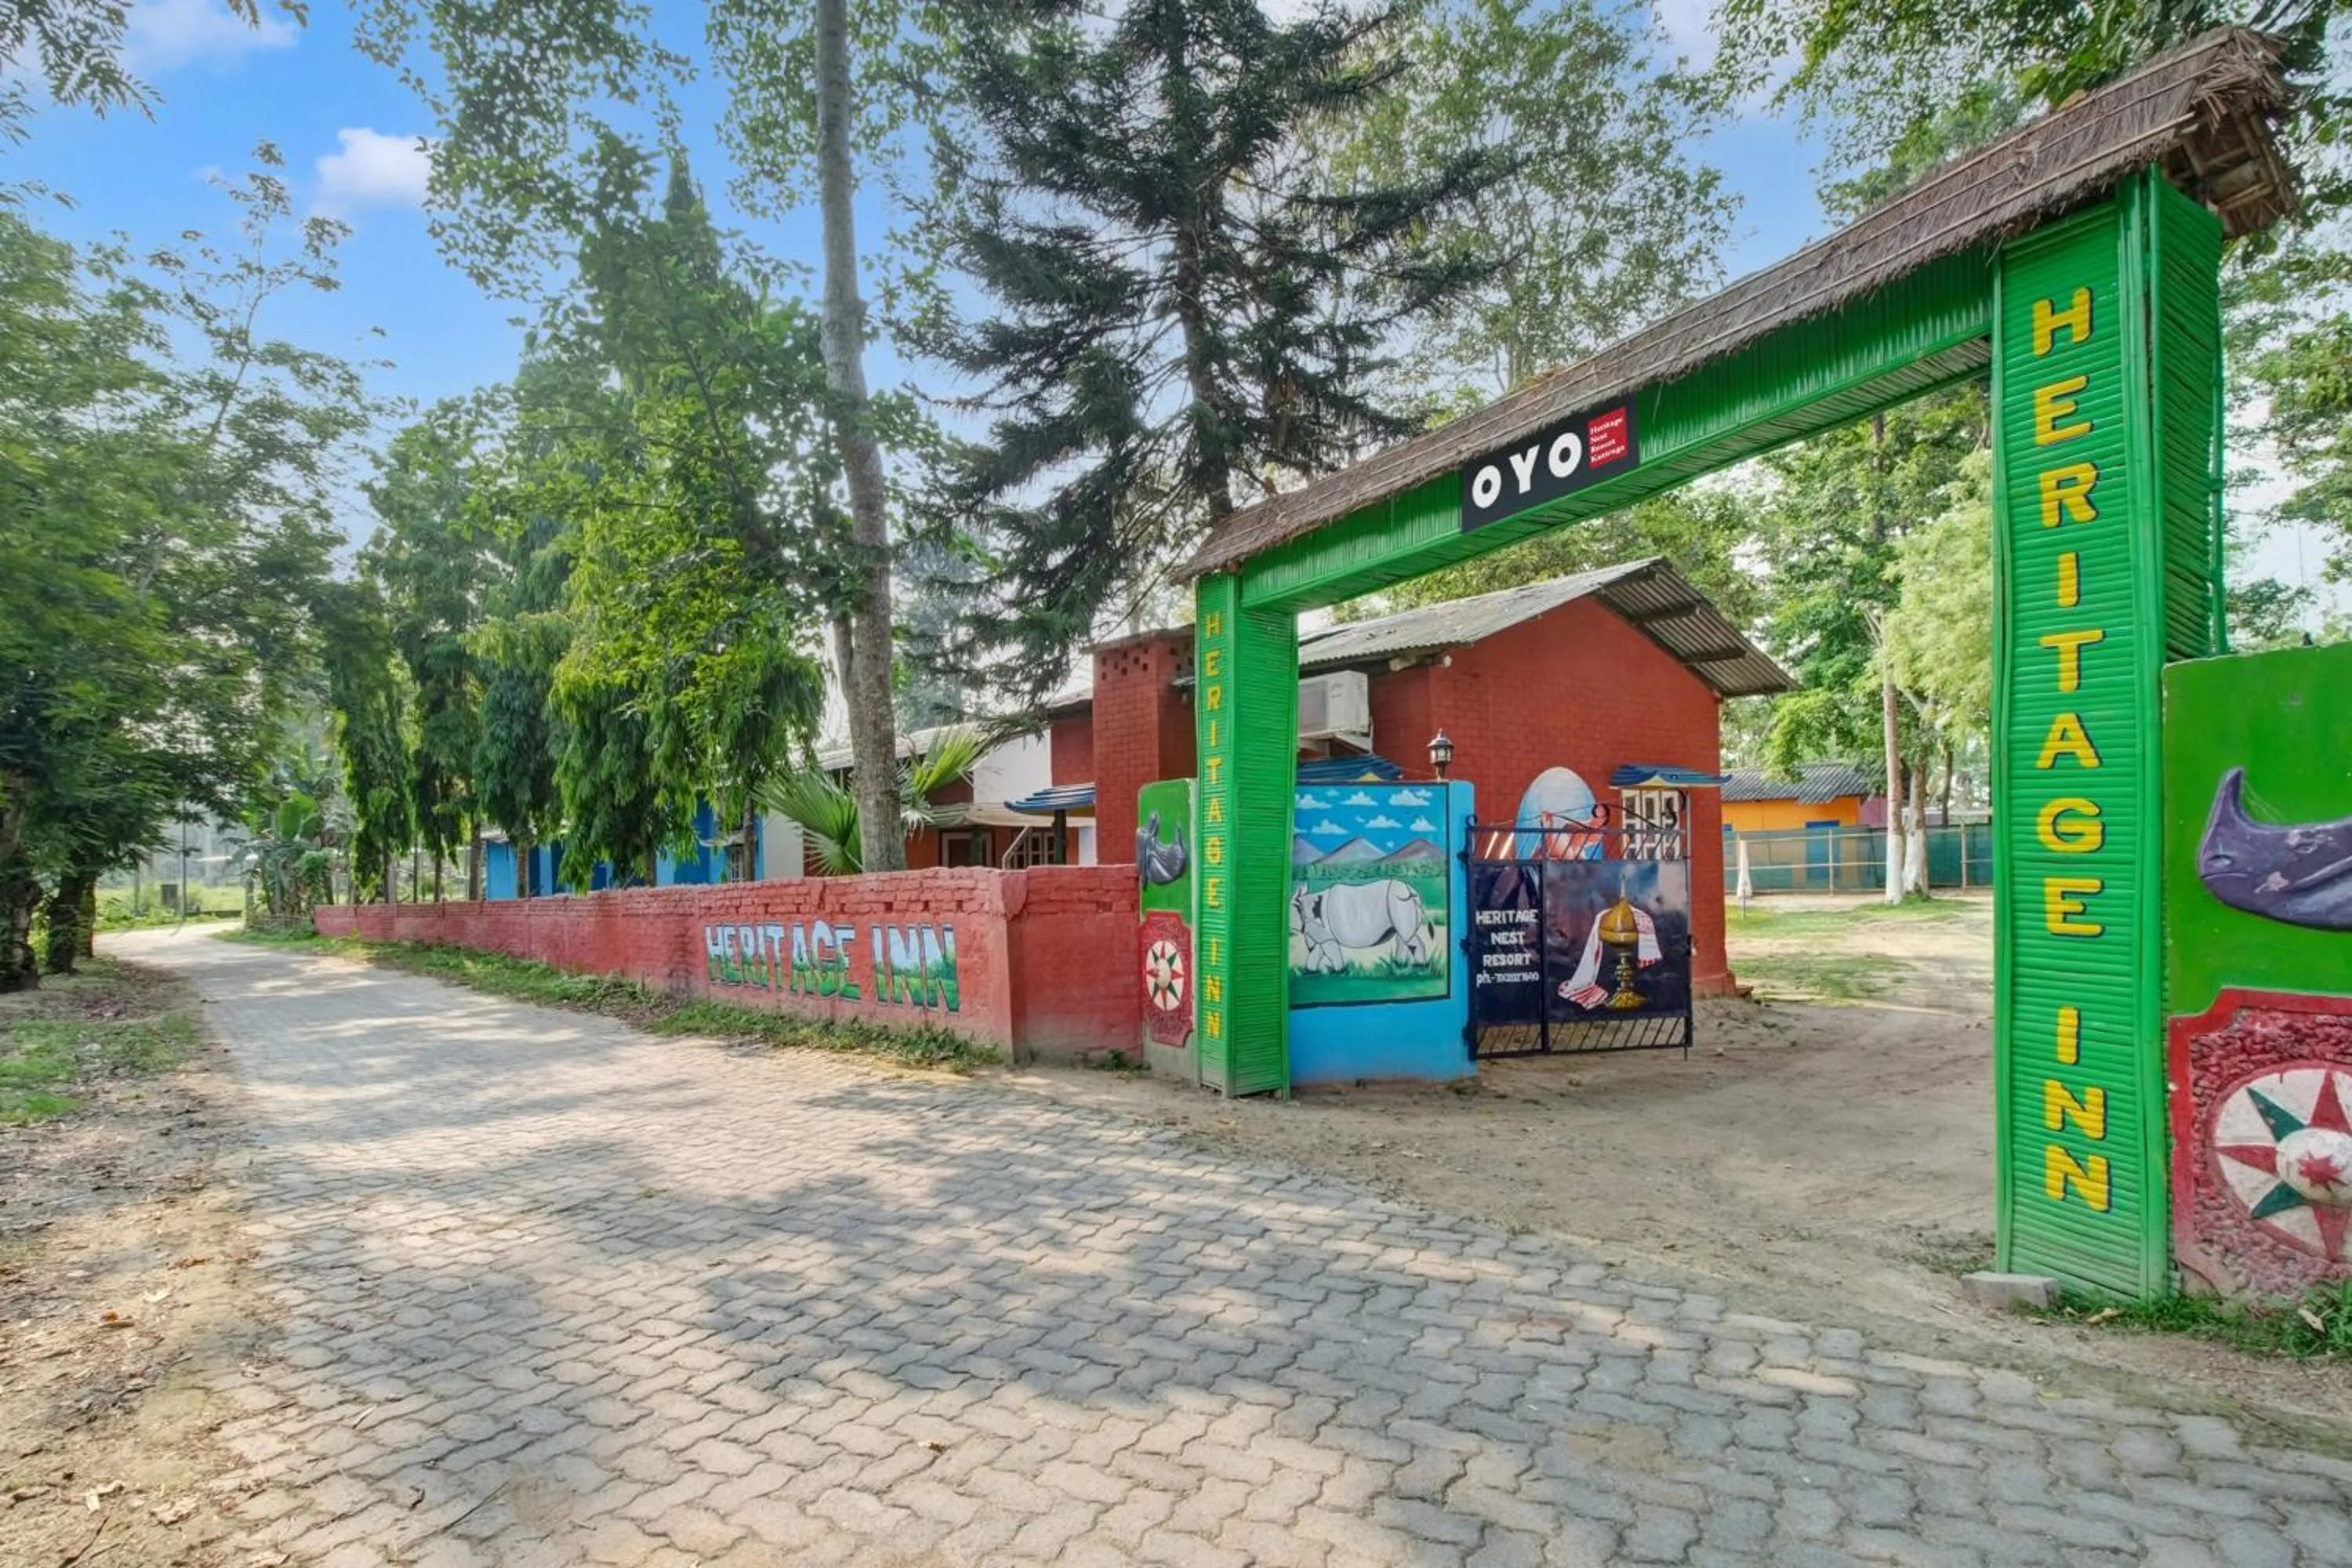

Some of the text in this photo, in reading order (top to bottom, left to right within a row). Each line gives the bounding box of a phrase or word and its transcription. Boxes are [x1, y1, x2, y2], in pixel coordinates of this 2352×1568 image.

[1472, 432, 1582, 509] OYO
[2032, 286, 2111, 1213] HERITAGE INN
[1204, 611, 1223, 1040] HERITAGE INN
[1475, 909, 1538, 926] HERITAGE
[1490, 931, 1526, 946] NEST
[703, 918, 960, 1012] HERITAGE INN
[1483, 953, 1532, 967] RESORT
